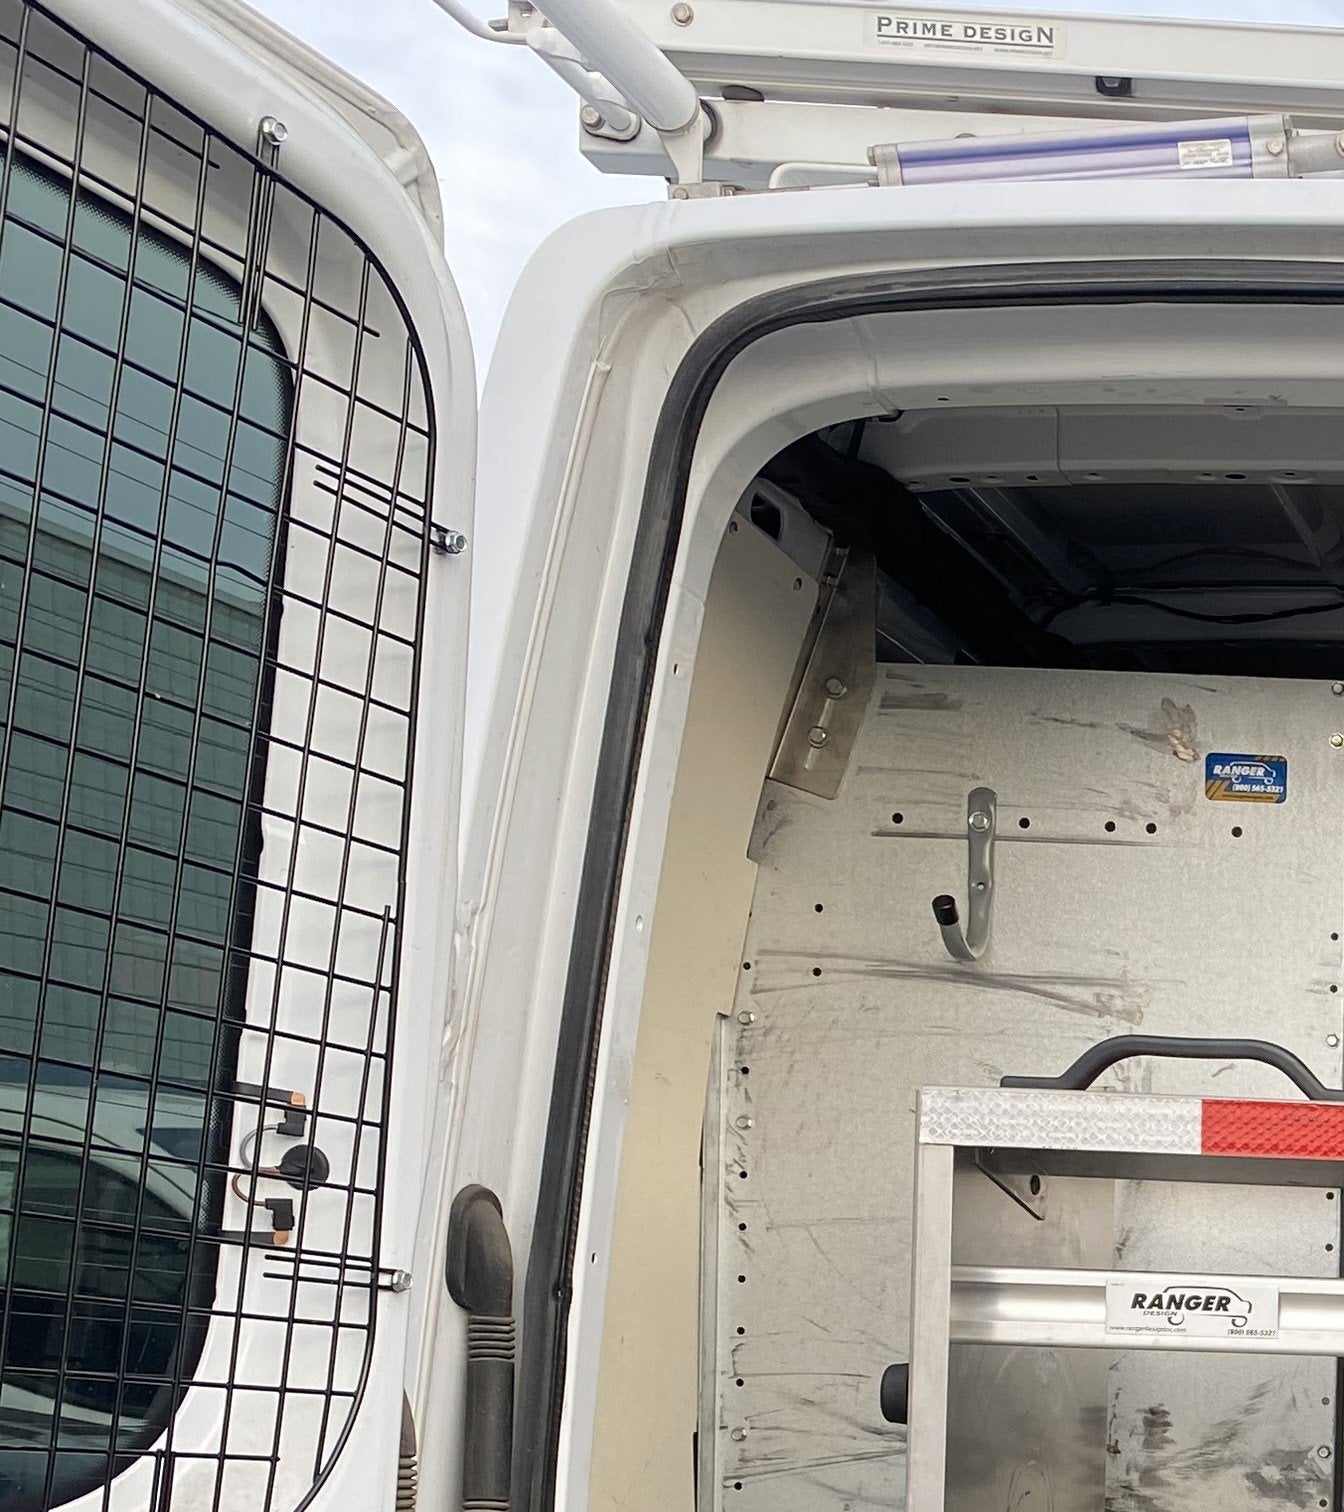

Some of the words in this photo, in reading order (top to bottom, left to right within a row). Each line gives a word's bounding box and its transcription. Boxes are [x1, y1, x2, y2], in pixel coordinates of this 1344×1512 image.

[877, 16, 953, 37] PRIME
[963, 25, 1055, 44] DESIGN
[1213, 765, 1265, 776] RANGER
[1130, 1292, 1232, 1313] RANGER
